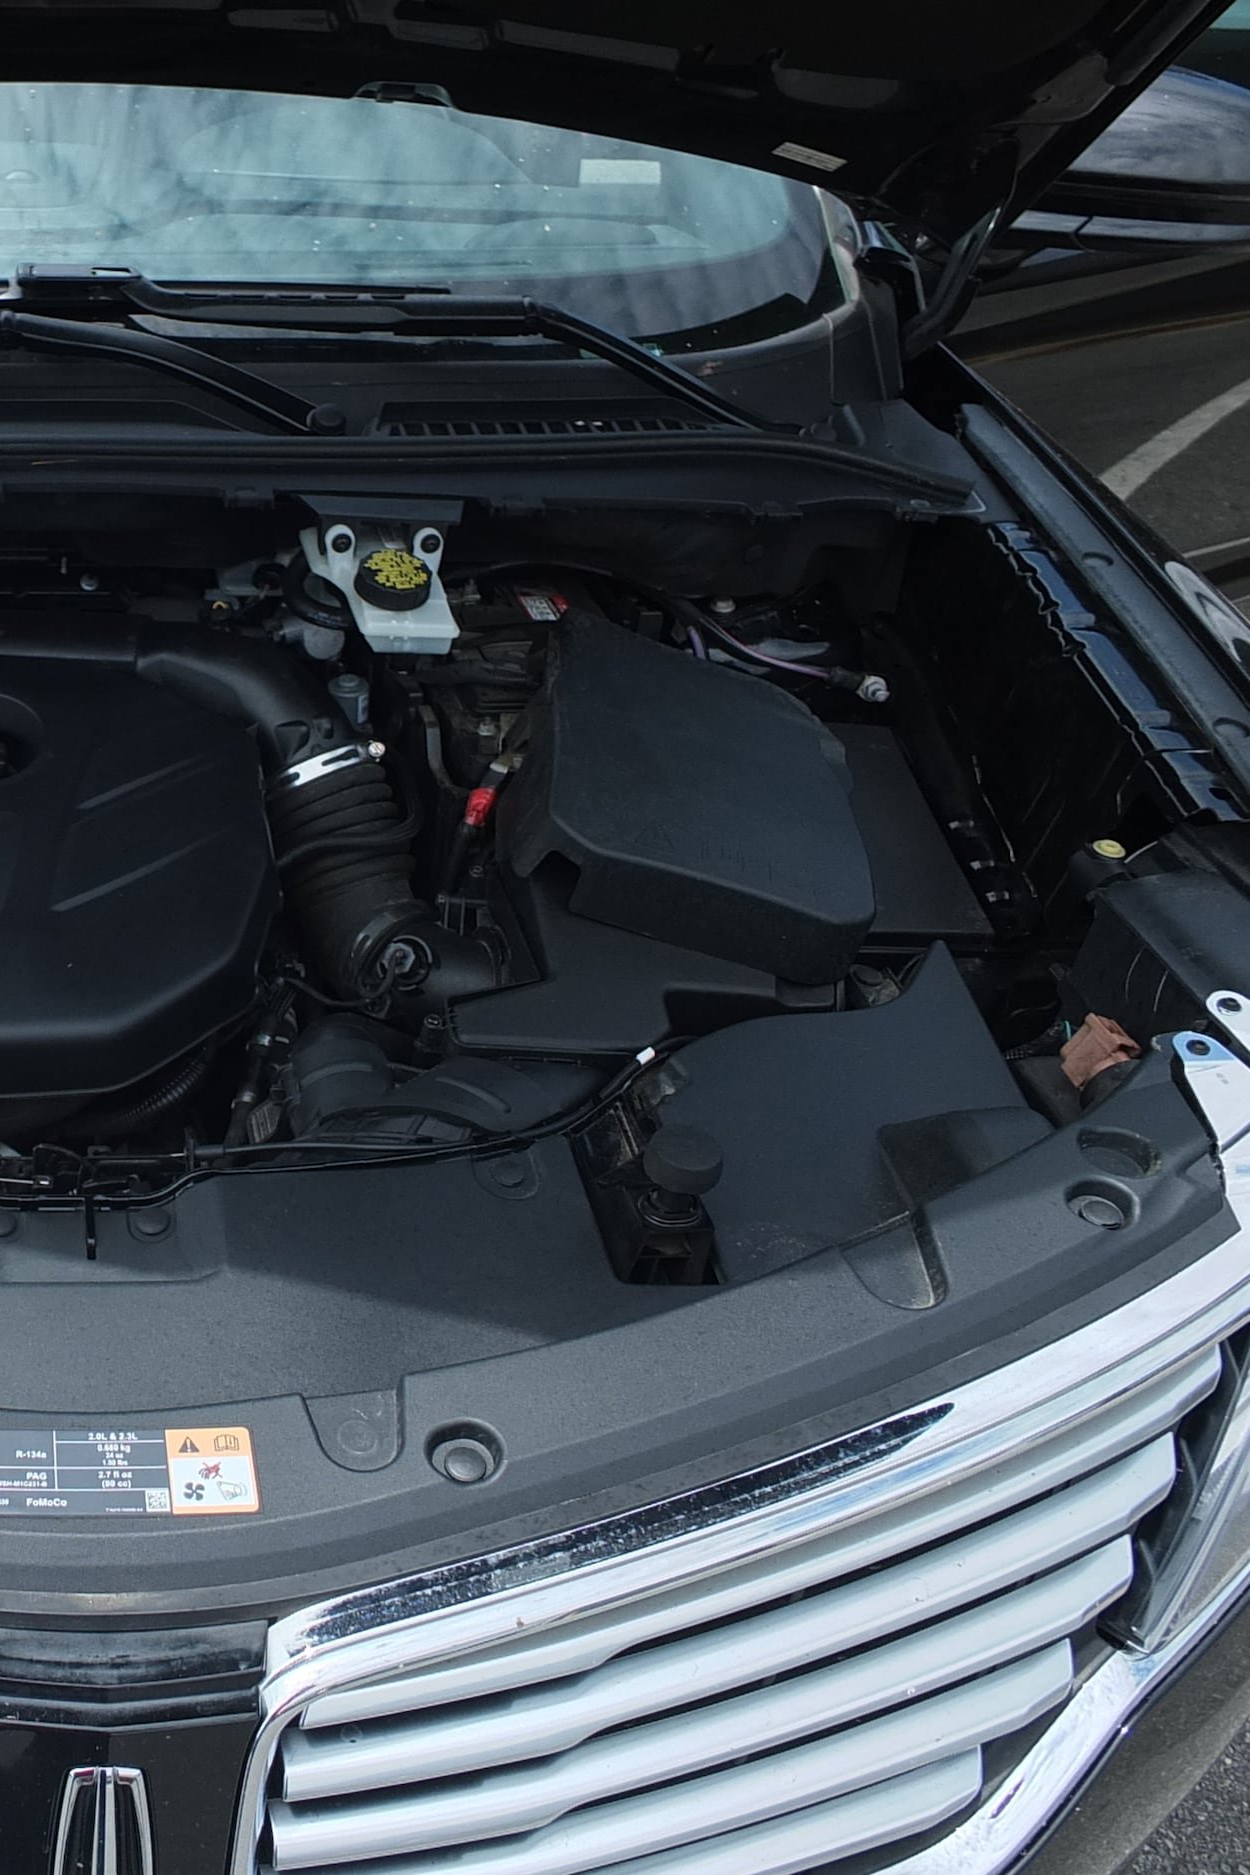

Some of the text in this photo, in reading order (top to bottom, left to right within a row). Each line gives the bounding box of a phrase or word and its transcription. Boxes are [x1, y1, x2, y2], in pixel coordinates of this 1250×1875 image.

[88, 1432, 108, 1440] 2.0L
[109, 1432, 117, 1440] &
[120, 1444, 131, 1453] kg
[15, 1450, 47, 1459] R-134a
[26, 1472, 47, 1480] PAG
[98, 1471, 111, 1479] 2.7
[121, 1471, 133, 1479] oz
[117, 1479, 132, 1489] cc)
[26, 1498, 68, 1507] FoMoCo
